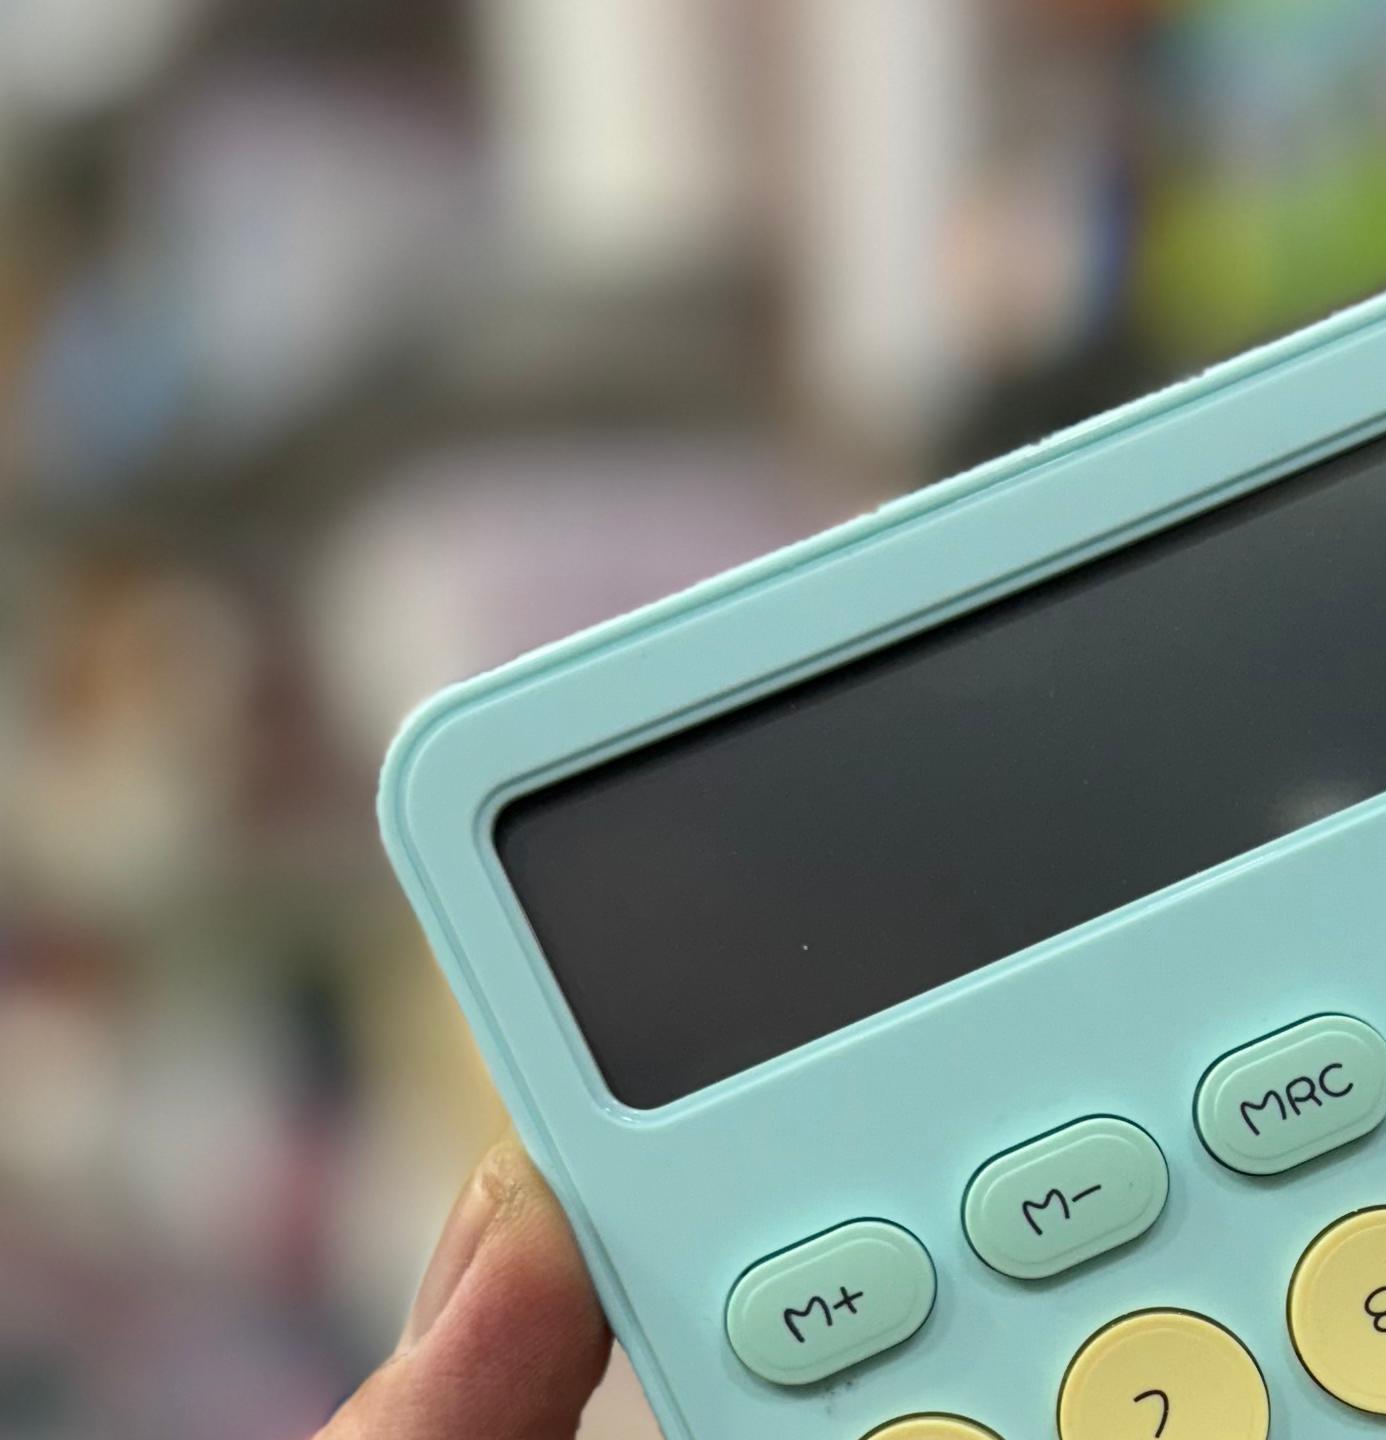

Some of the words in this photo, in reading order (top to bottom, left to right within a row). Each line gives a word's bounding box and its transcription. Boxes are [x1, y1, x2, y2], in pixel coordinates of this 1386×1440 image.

[1240, 1062, 1354, 1136] MRC
[783, 1286, 864, 1344] M+
[1133, 1389, 1170, 1439] 7
